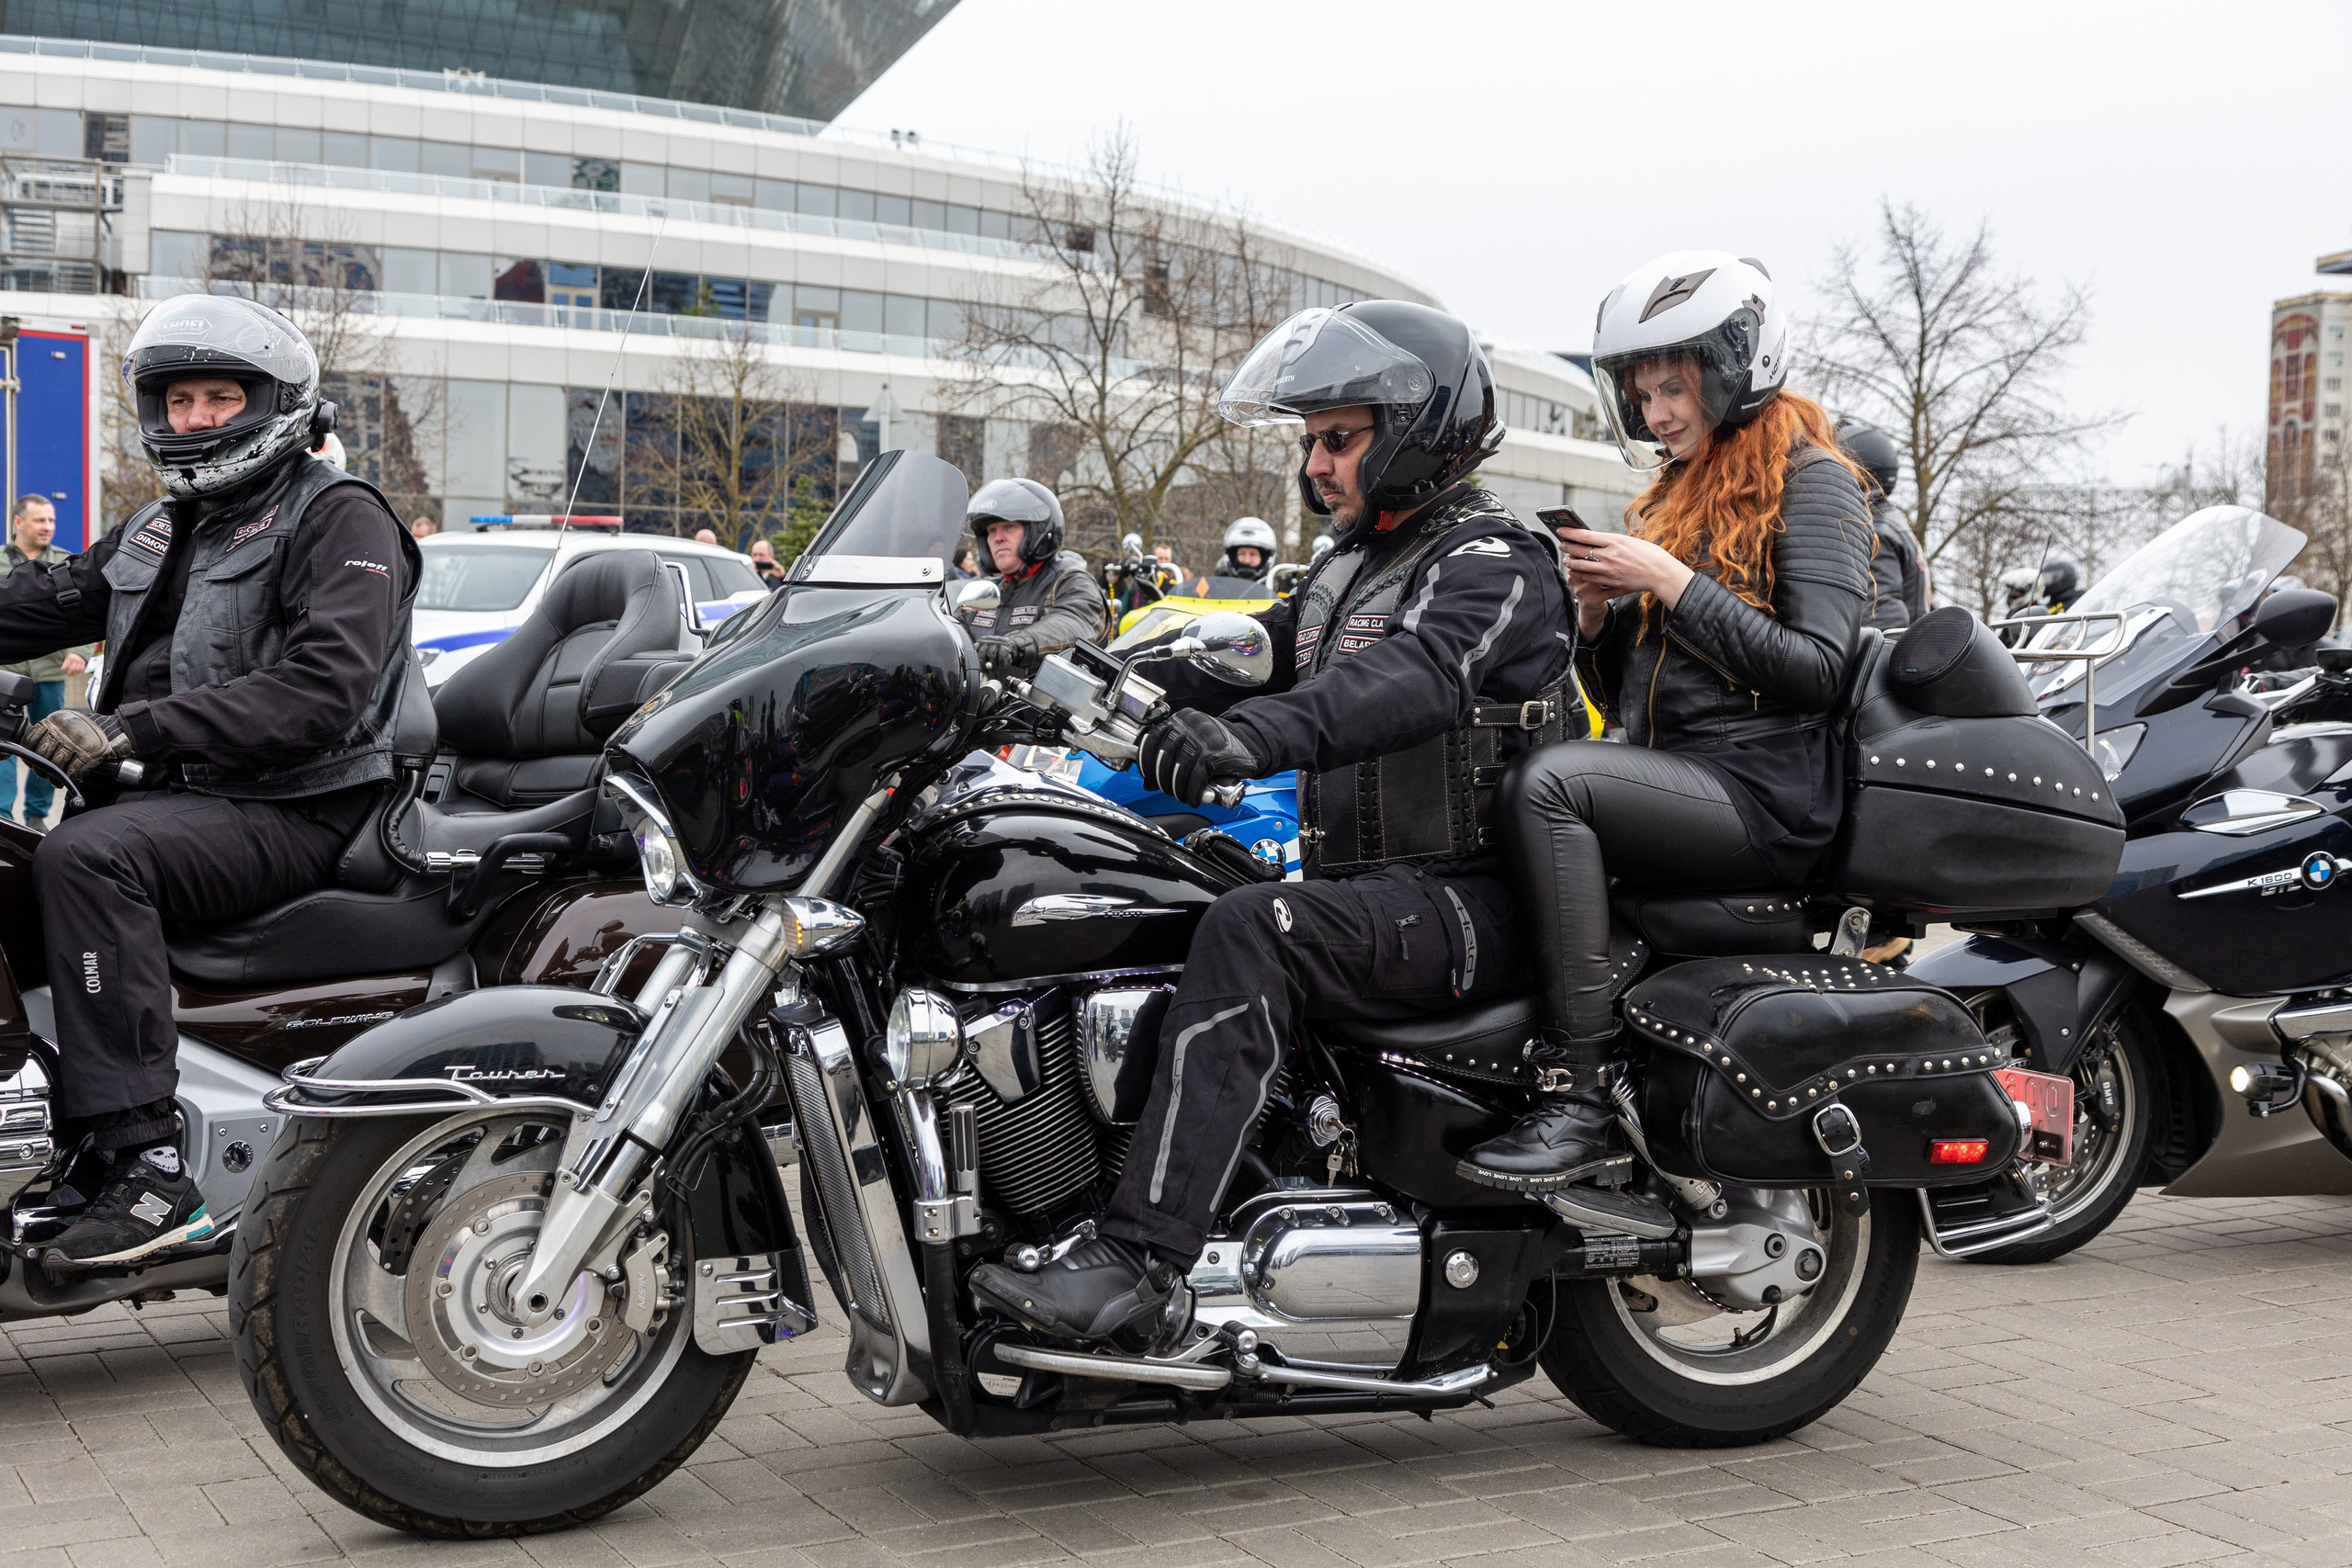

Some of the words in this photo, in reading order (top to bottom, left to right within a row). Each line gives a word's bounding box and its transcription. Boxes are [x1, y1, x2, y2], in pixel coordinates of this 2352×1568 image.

[1350, 618, 1370, 627] RACING
[1252, 840, 1280, 854] BMW
[2247, 879, 2258, 887] K
[2261, 873, 2293, 885] 1600
[2261, 880, 2302, 897] GTL
[83, 952, 102, 993] COLMAR
[444, 1066, 566, 1081] Tourer
[2102, 1081, 2114, 1105] BMW
[130, 1191, 173, 1226] N
